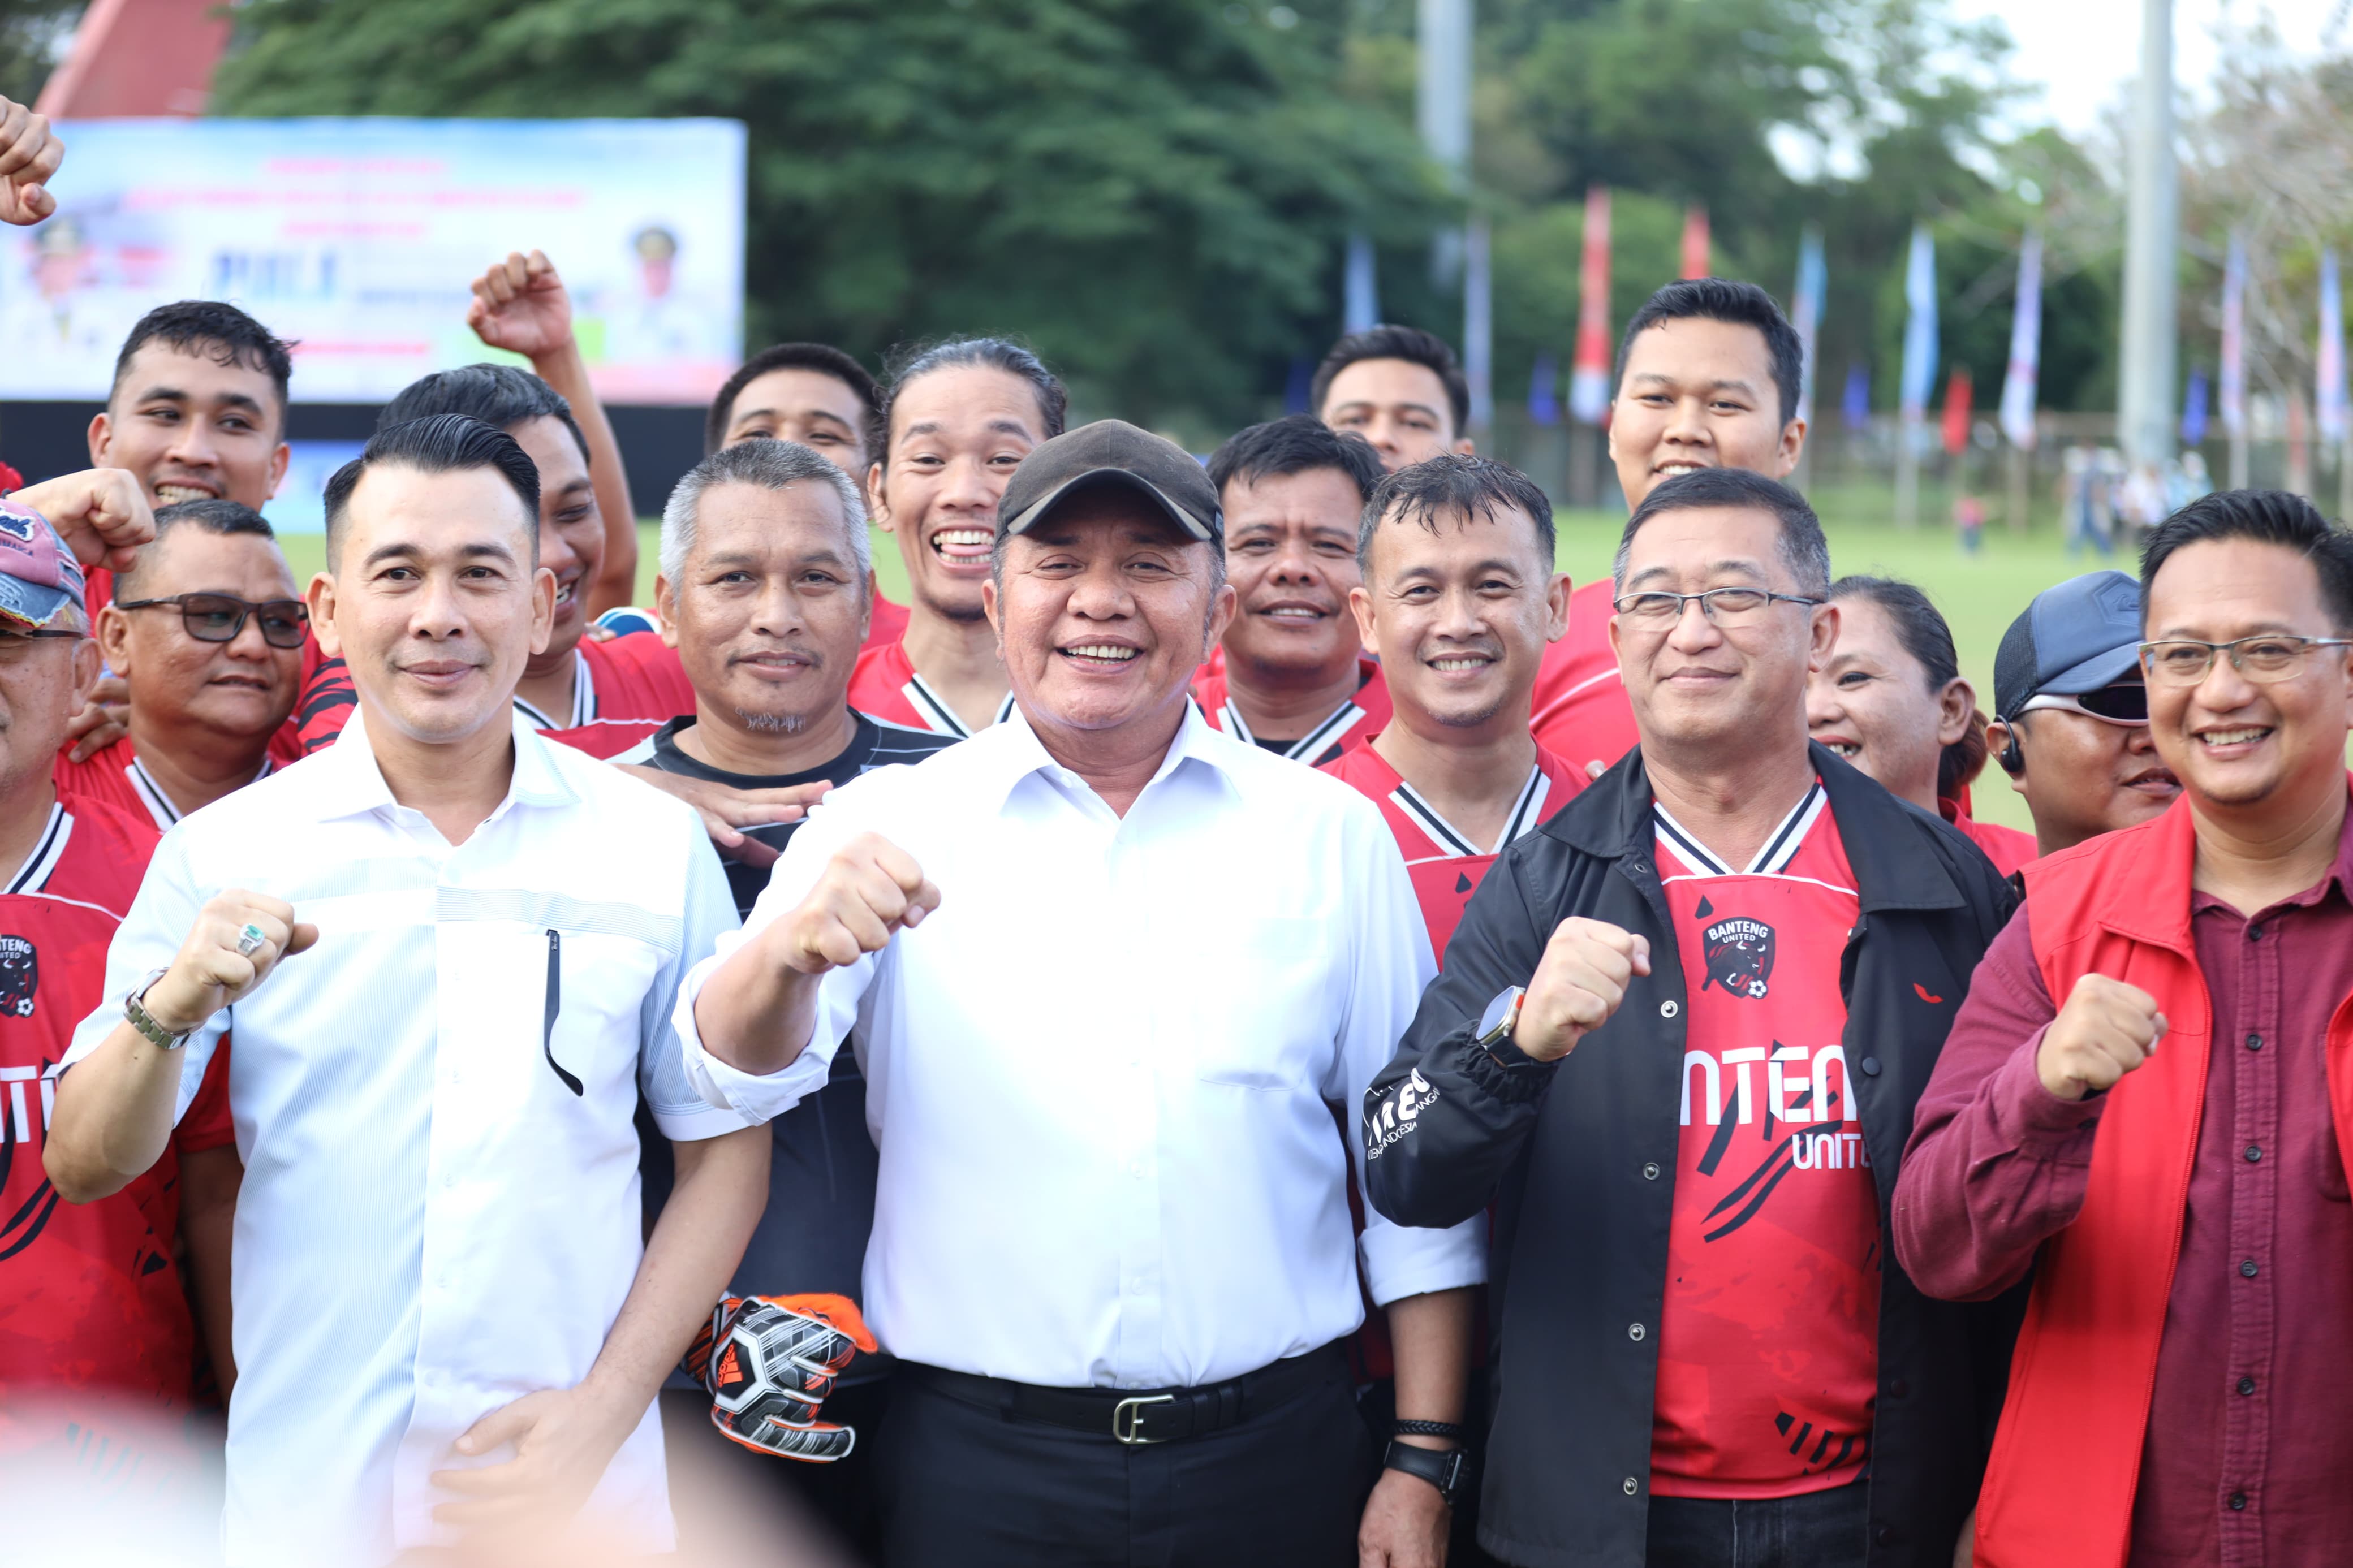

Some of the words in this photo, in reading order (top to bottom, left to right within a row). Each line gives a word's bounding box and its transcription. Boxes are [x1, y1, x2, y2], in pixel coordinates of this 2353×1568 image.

[1708, 921, 1768, 941] BANTENG
[1722, 934, 1756, 943] UNITED
[0, 939, 32, 954] TENG
[718, 1344, 734, 1388] adidas
